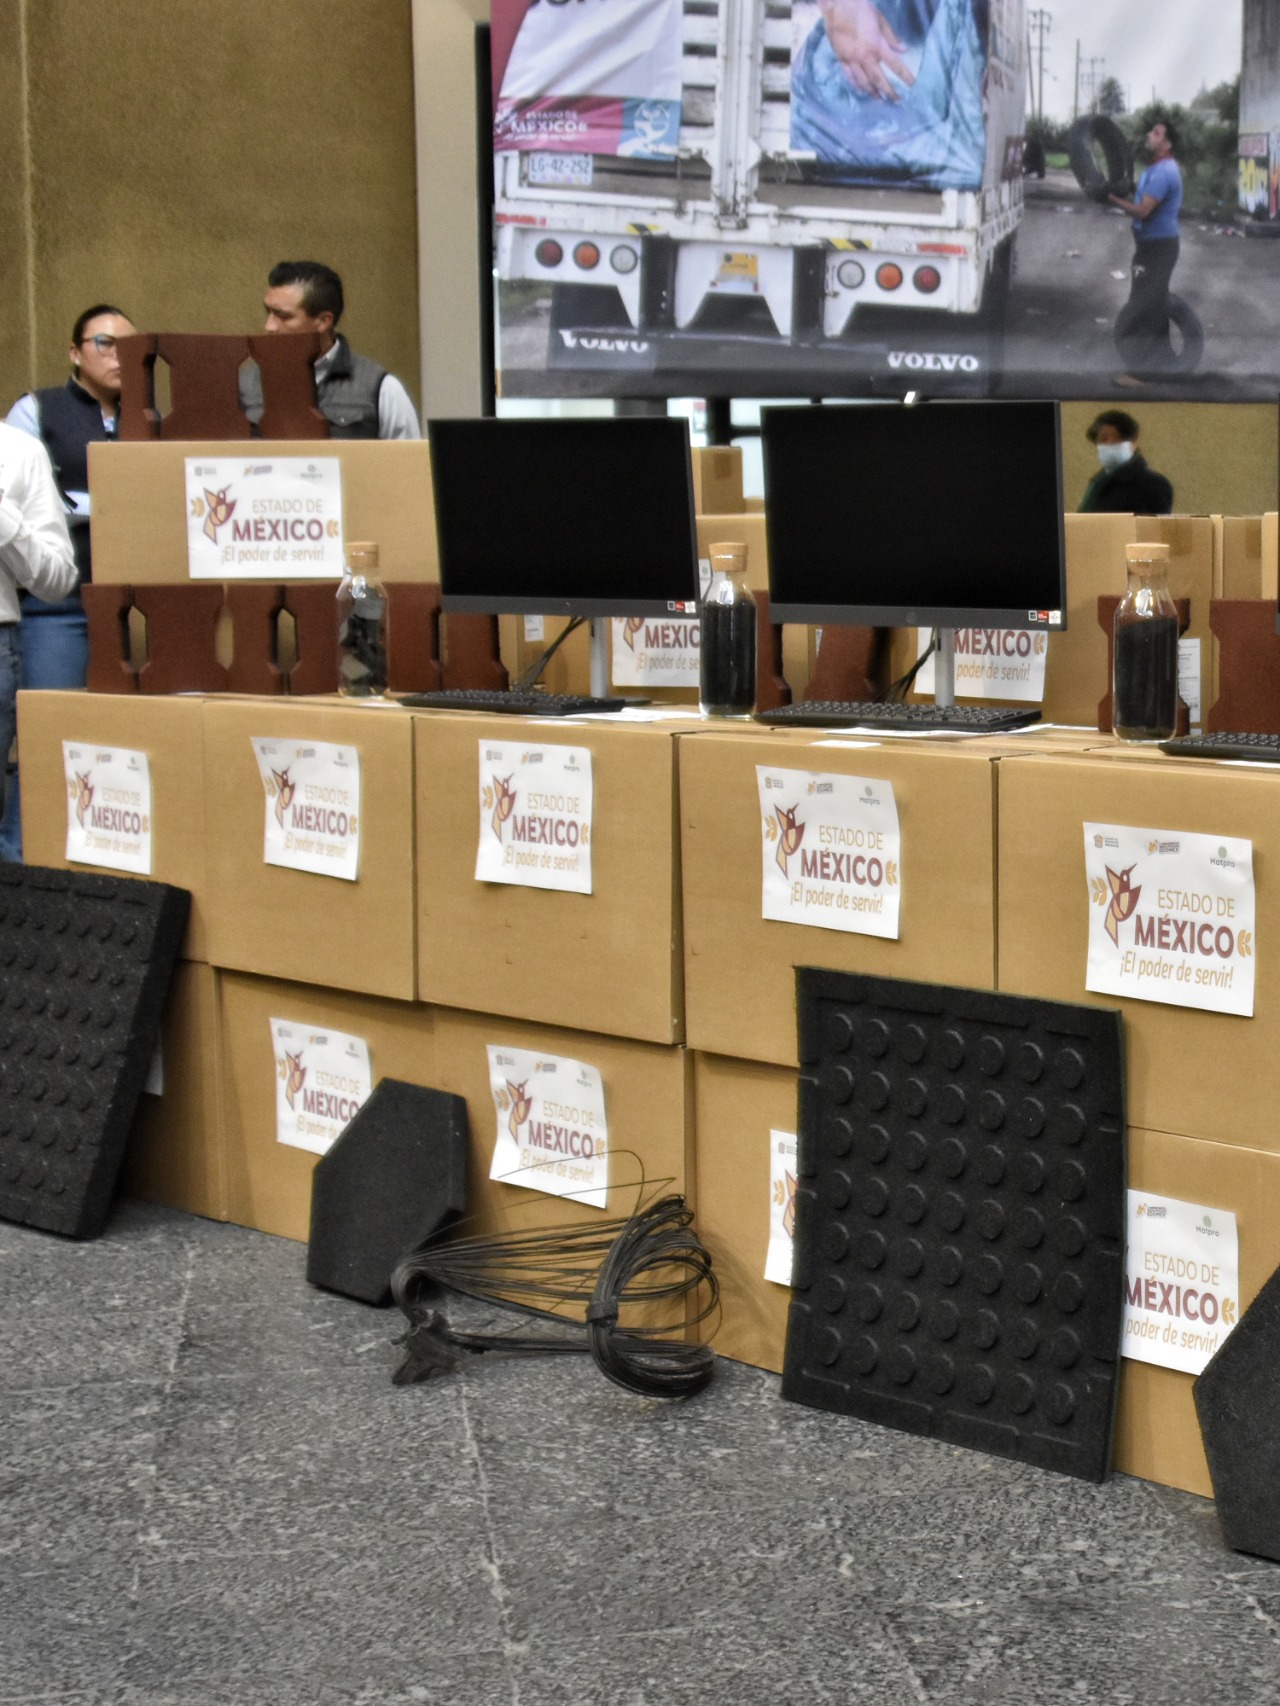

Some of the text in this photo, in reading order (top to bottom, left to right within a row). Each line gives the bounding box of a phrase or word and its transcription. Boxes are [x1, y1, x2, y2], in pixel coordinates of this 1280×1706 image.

[887, 351, 978, 371] VOLVO
[252, 499, 323, 513] ESTADO DE
[232, 516, 323, 542] MÉXICO
[238, 545, 270, 564] poder
[273, 546, 287, 561] de
[291, 545, 324, 561] servir!
[645, 621, 700, 649] MÉXIC
[648, 653, 673, 672] poder
[676, 654, 686, 670] de
[957, 661, 1030, 681] poder de servir!
[527, 793, 580, 814] ESTADO DE
[91, 805, 140, 835] MÉXICO
[292, 803, 348, 837] MÉXICO
[512, 813, 579, 847] MÉXICO
[819, 825, 883, 850] ESTADO DE
[516, 848, 538, 868] poder
[541, 850, 551, 868] de
[801, 847, 883, 887] MÉXICO
[1210, 858, 1235, 868] Matpro
[791, 882, 883, 914] ¡El poder de servir!
[1158, 889, 1235, 918] ESTADO DE
[1134, 913, 1234, 959] MÉXICO
[1120, 951, 1234, 989] ¡El poder de servir!
[543, 1101, 594, 1128] ESTADO DE
[528, 1119, 594, 1160] MÉXICO
[1196, 1225, 1219, 1237] Matpro
[1144, 1251, 1219, 1286] ESTADO DE
[1125, 1274, 1219, 1325] MÉXICO
[1126, 1317, 1218, 1354] poder de servir!
